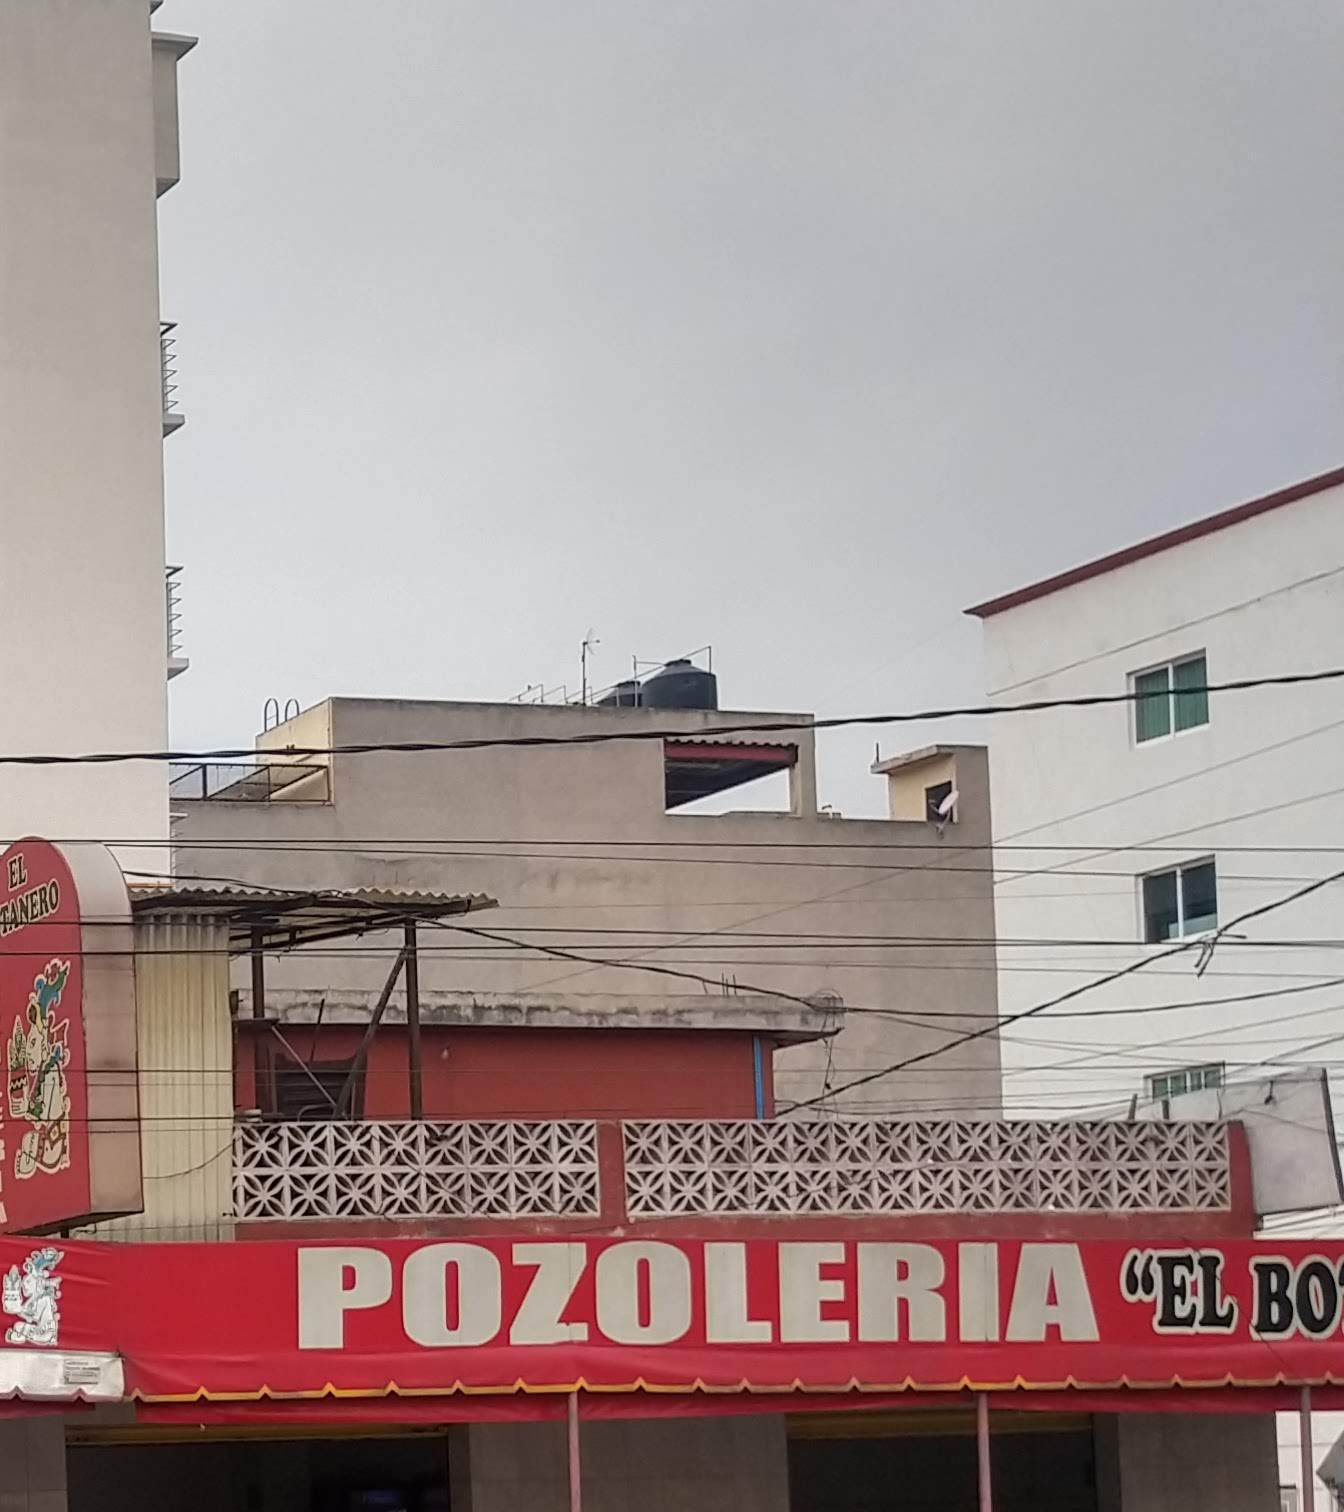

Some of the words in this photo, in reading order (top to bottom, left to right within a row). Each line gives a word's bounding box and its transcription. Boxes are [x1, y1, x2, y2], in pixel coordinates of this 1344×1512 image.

[7, 853, 27, 891] EL
[297, 1240, 1100, 1349] POZOLERIA
[1249, 1254, 1344, 1341] BO
